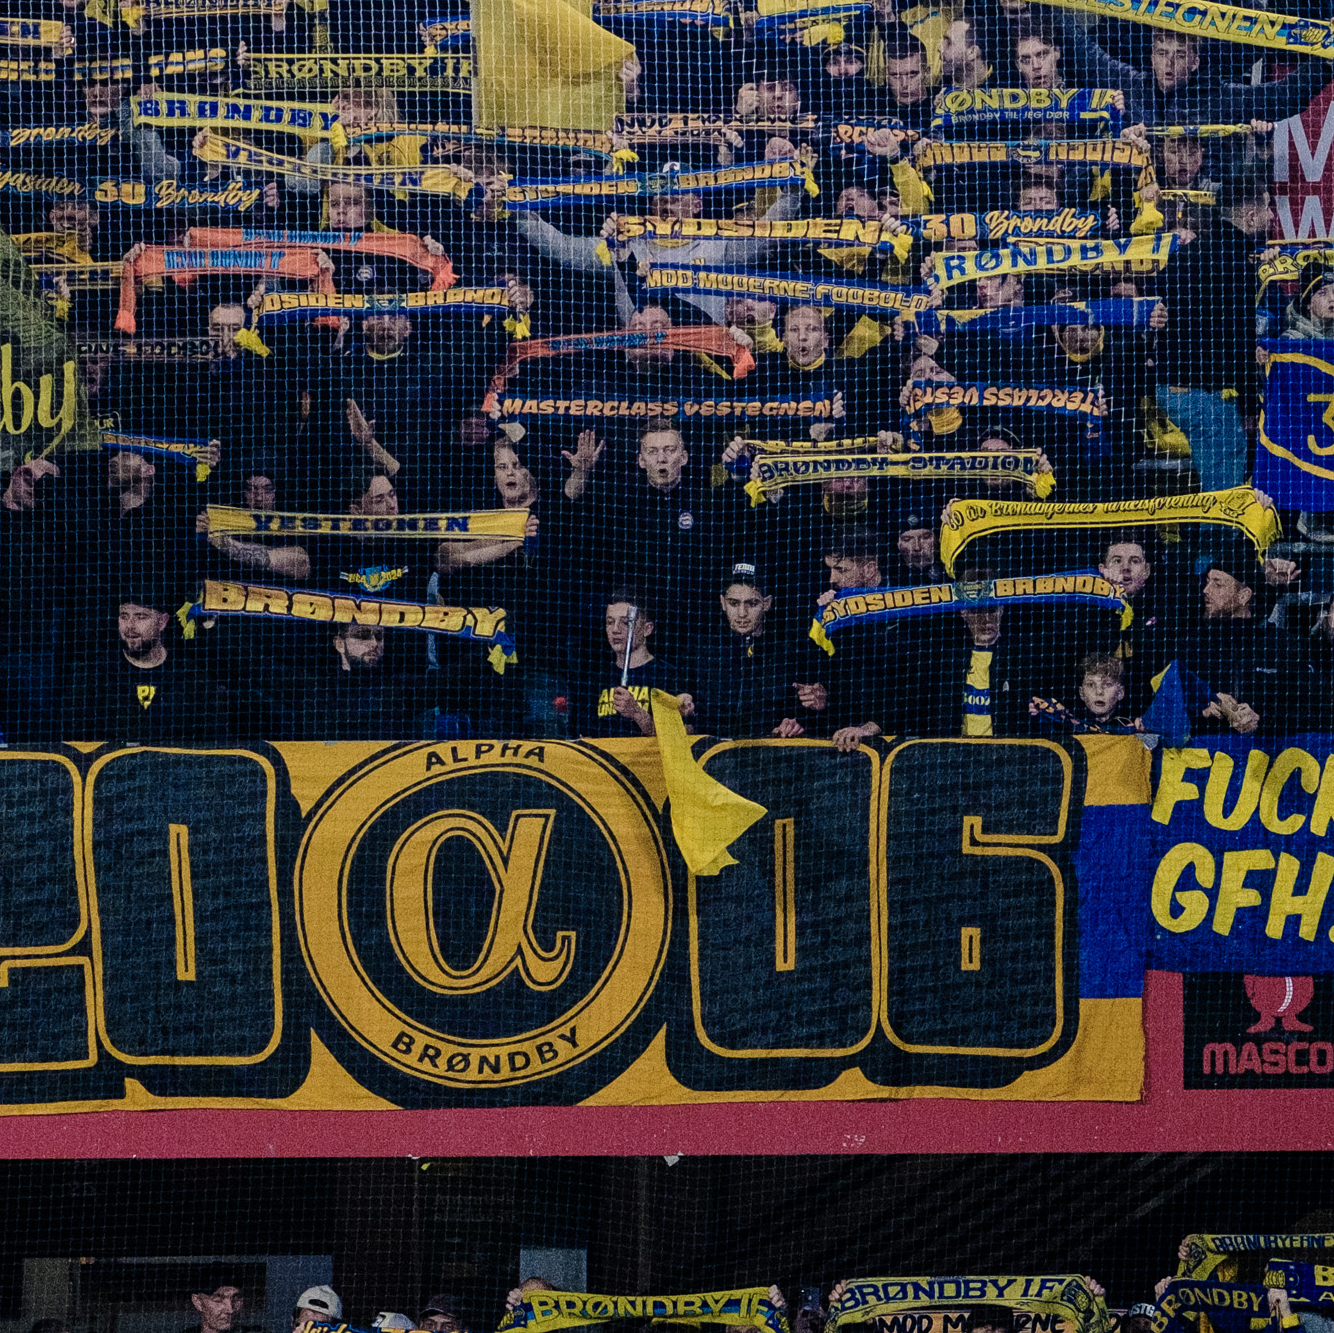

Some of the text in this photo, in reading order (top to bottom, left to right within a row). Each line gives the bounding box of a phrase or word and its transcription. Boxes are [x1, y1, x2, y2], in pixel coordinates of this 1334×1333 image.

[945, 87, 1078, 111] ØNDBY
[136, 97, 340, 133] BRØNDBY
[617, 217, 881, 244] SYDSIDEN
[920, 211, 977, 241] 30
[942, 234, 1134, 278] RØNDBY
[265, 293, 364, 314] DSIDEN
[502, 397, 832, 418] MASTERCLASS VESTEGNEN
[201, 577, 507, 639] BRØNDBY
[823, 574, 1125, 623] SYDSIDEN BRØNDBY
[424, 741, 547, 772] ALPHA
[391, 1027, 584, 1078] BRØNDBY
[841, 1276, 1019, 1309] BRØNDBY
[531, 1294, 717, 1323] BRØNDBY
